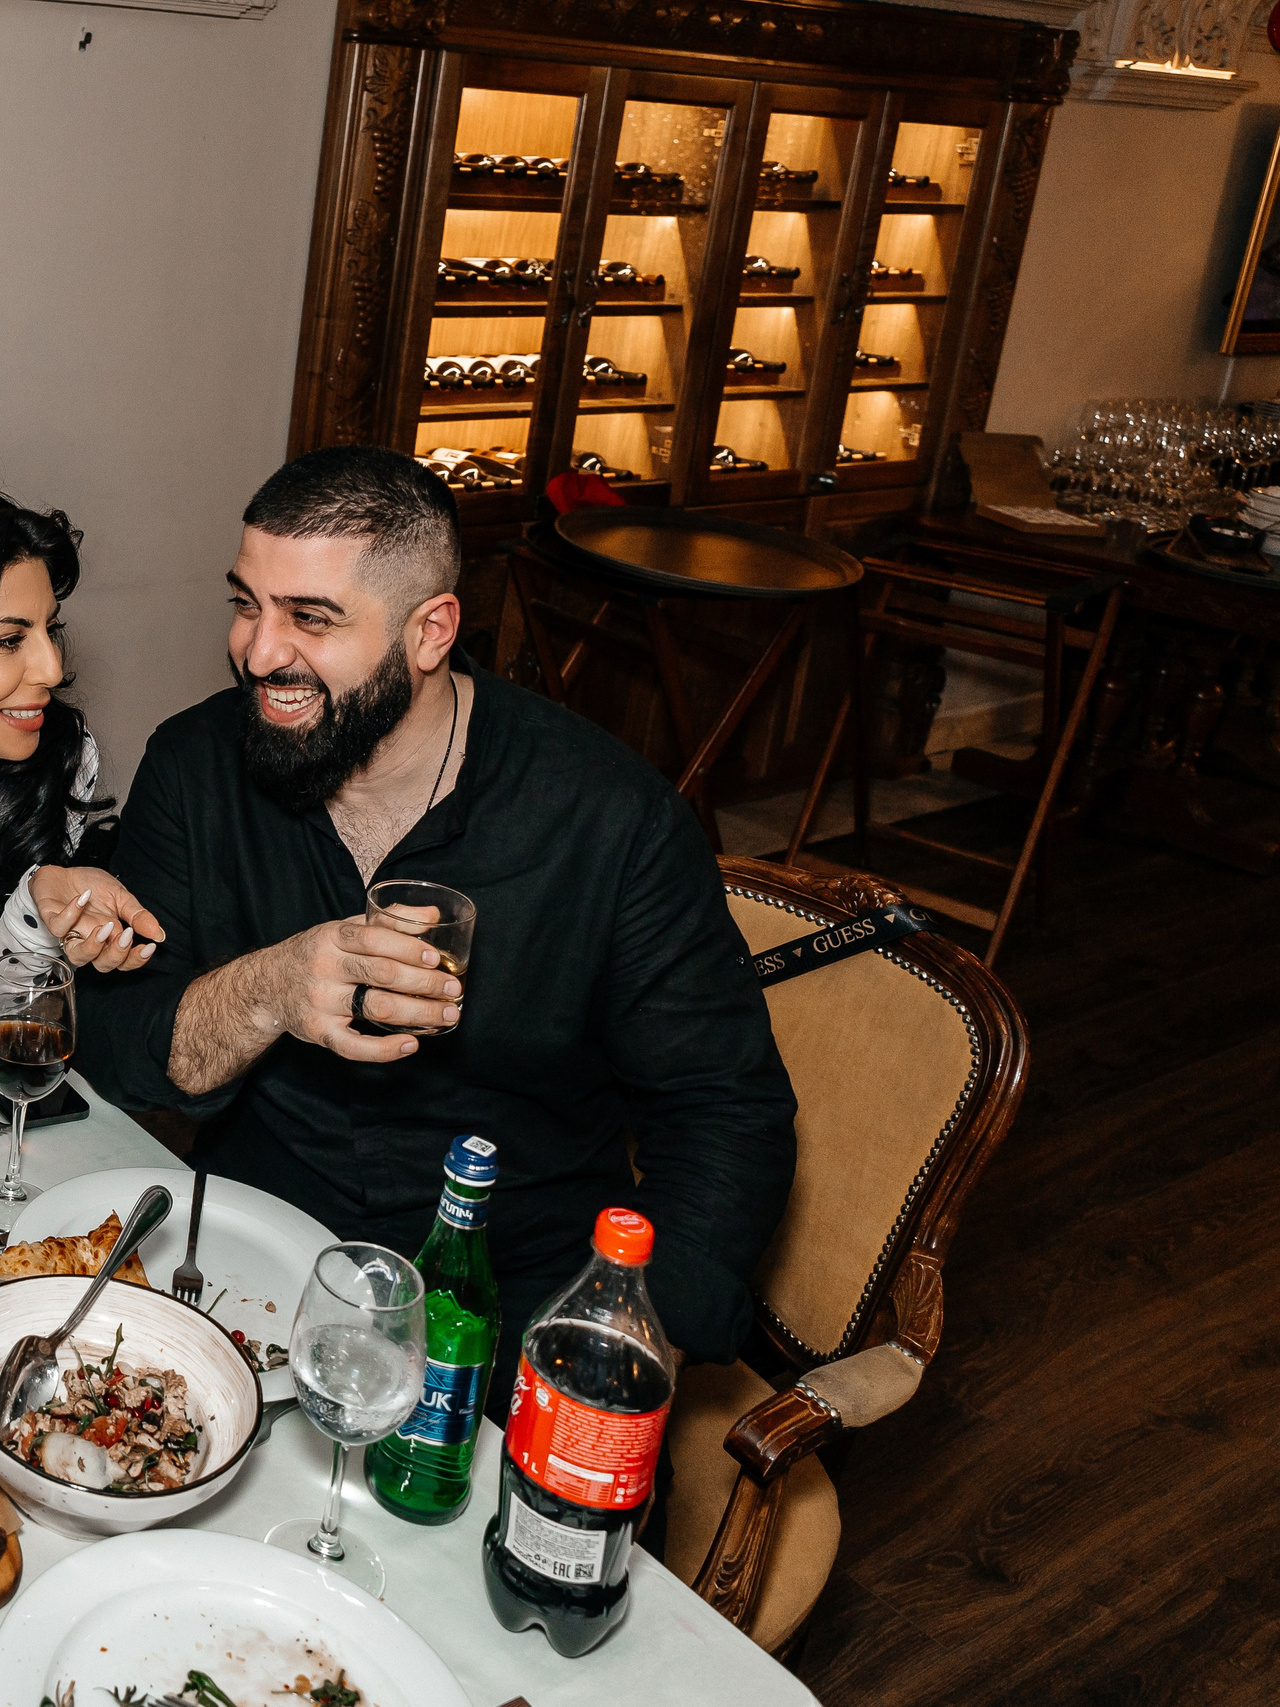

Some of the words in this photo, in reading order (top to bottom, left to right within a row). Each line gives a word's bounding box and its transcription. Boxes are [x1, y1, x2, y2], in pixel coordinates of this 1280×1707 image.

[754, 953, 785, 976] ESS
[813, 919, 876, 953] GUESS
[522, 1452, 529, 1464] 1
